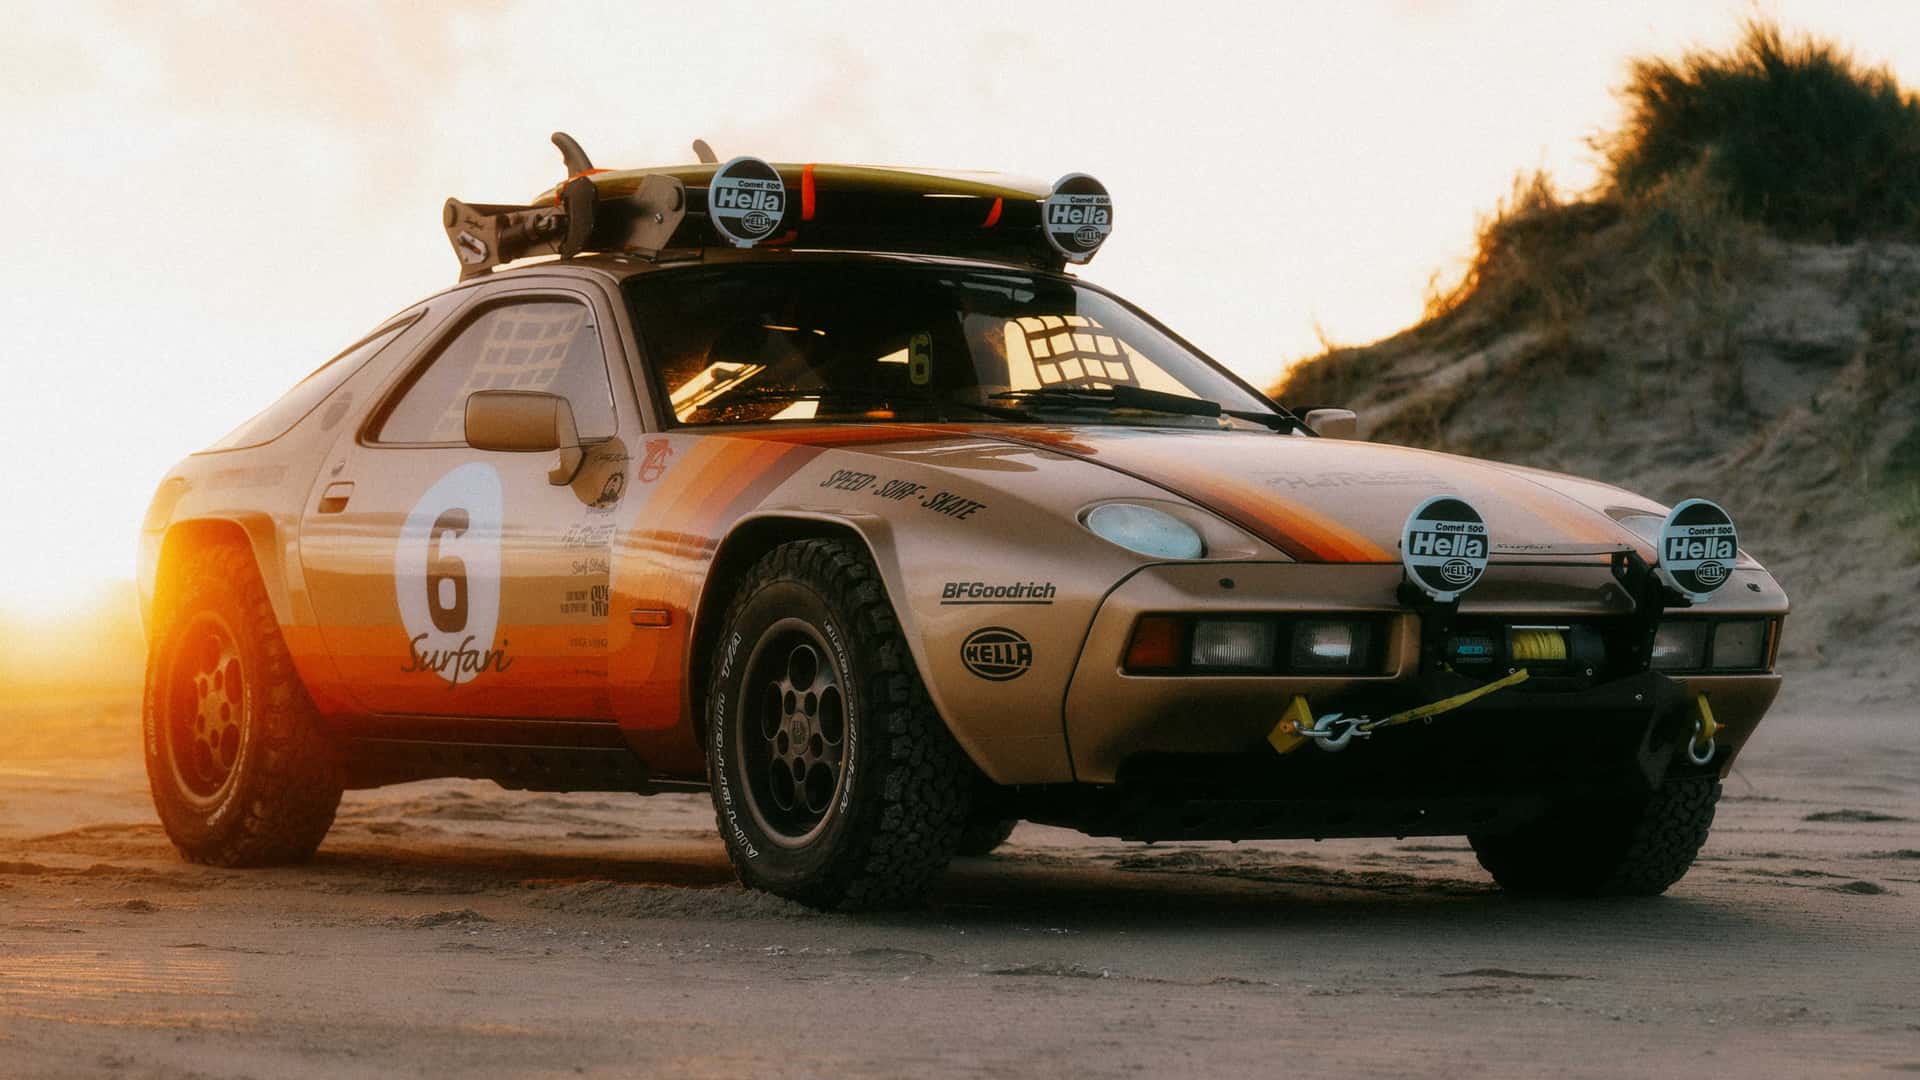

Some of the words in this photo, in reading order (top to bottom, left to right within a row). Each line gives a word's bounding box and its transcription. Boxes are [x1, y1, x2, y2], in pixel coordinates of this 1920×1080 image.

[718, 188, 779, 210] Hella
[1051, 205, 1108, 224] Hella
[910, 334, 929, 385] 6
[819, 469, 876, 491] SPEED
[873, 479, 928, 501] SURF
[921, 491, 987, 520] SKATE
[1435, 522, 1465, 532] Comet
[1468, 525, 1485, 533] 500
[1688, 527, 1716, 535] Comet
[1718, 526, 1733, 534] 500
[1412, 532, 1483, 557] Hella
[1669, 537, 1733, 559] Hella
[427, 507, 470, 633] 6
[942, 582, 1056, 598] BFGoodrich
[401, 633, 513, 691] Surfari
